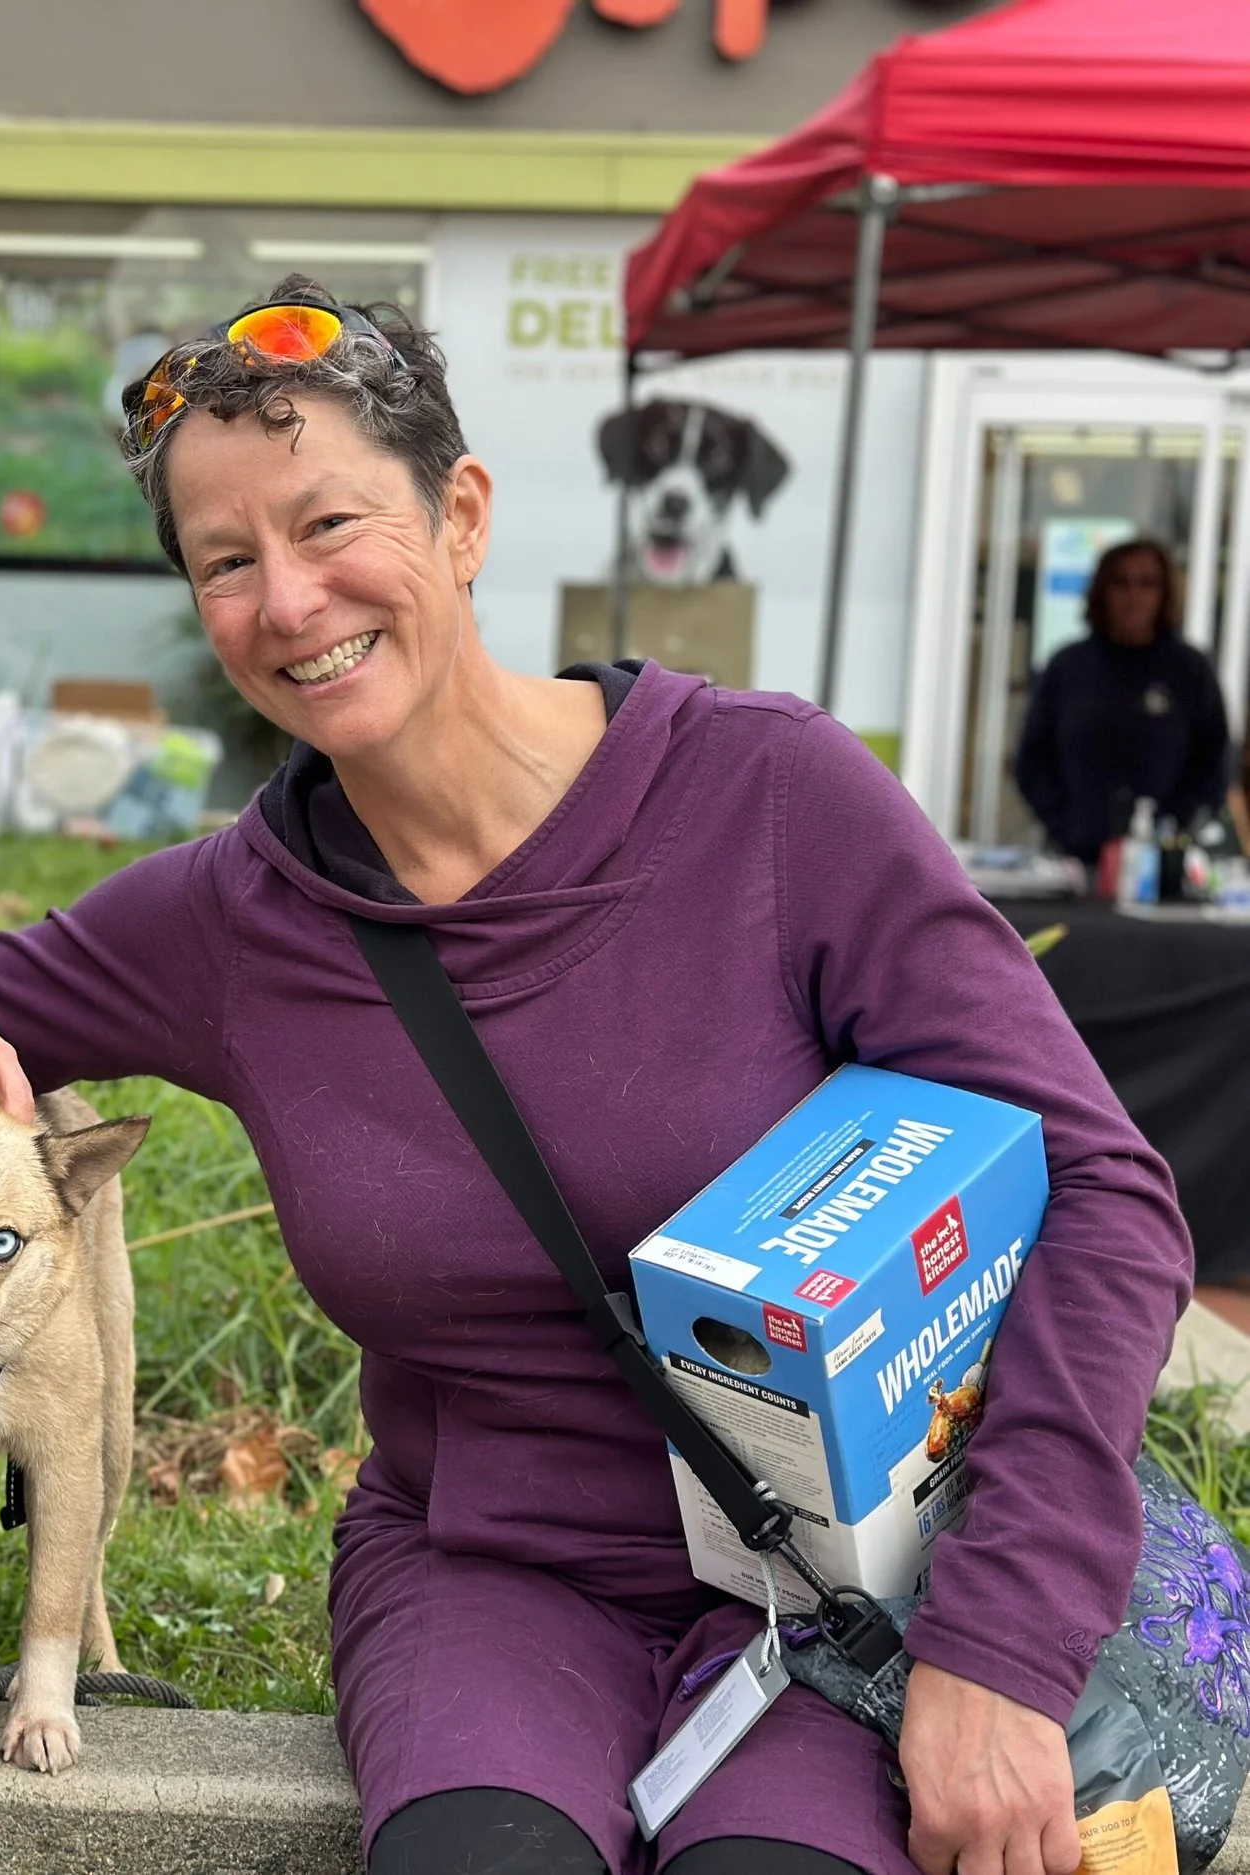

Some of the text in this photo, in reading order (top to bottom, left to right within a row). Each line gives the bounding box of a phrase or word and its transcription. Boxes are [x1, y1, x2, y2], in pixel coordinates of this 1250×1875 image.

[758, 1118, 954, 1265] WHOLEMADE
[920, 1238, 937, 1258] the
[923, 1231, 960, 1272] honest
[925, 1245, 963, 1285] kitchen
[767, 1315, 782, 1327] the
[769, 1323, 801, 1339] honest
[876, 1237, 1022, 1416] WHOLEMADE
[770, 1331, 803, 1347] kitchen
[848, 1343, 863, 1359] GREAT
[863, 1330, 876, 1345] TASTE
[680, 1360, 707, 1376] EVERY
[709, 1370, 760, 1396] INGREDIENT
[762, 1390, 798, 1410] COUNTS
[930, 1463, 950, 1488] GRAIN
[918, 1511, 931, 1538] 16
[1101, 1821, 1120, 1833] DOG
